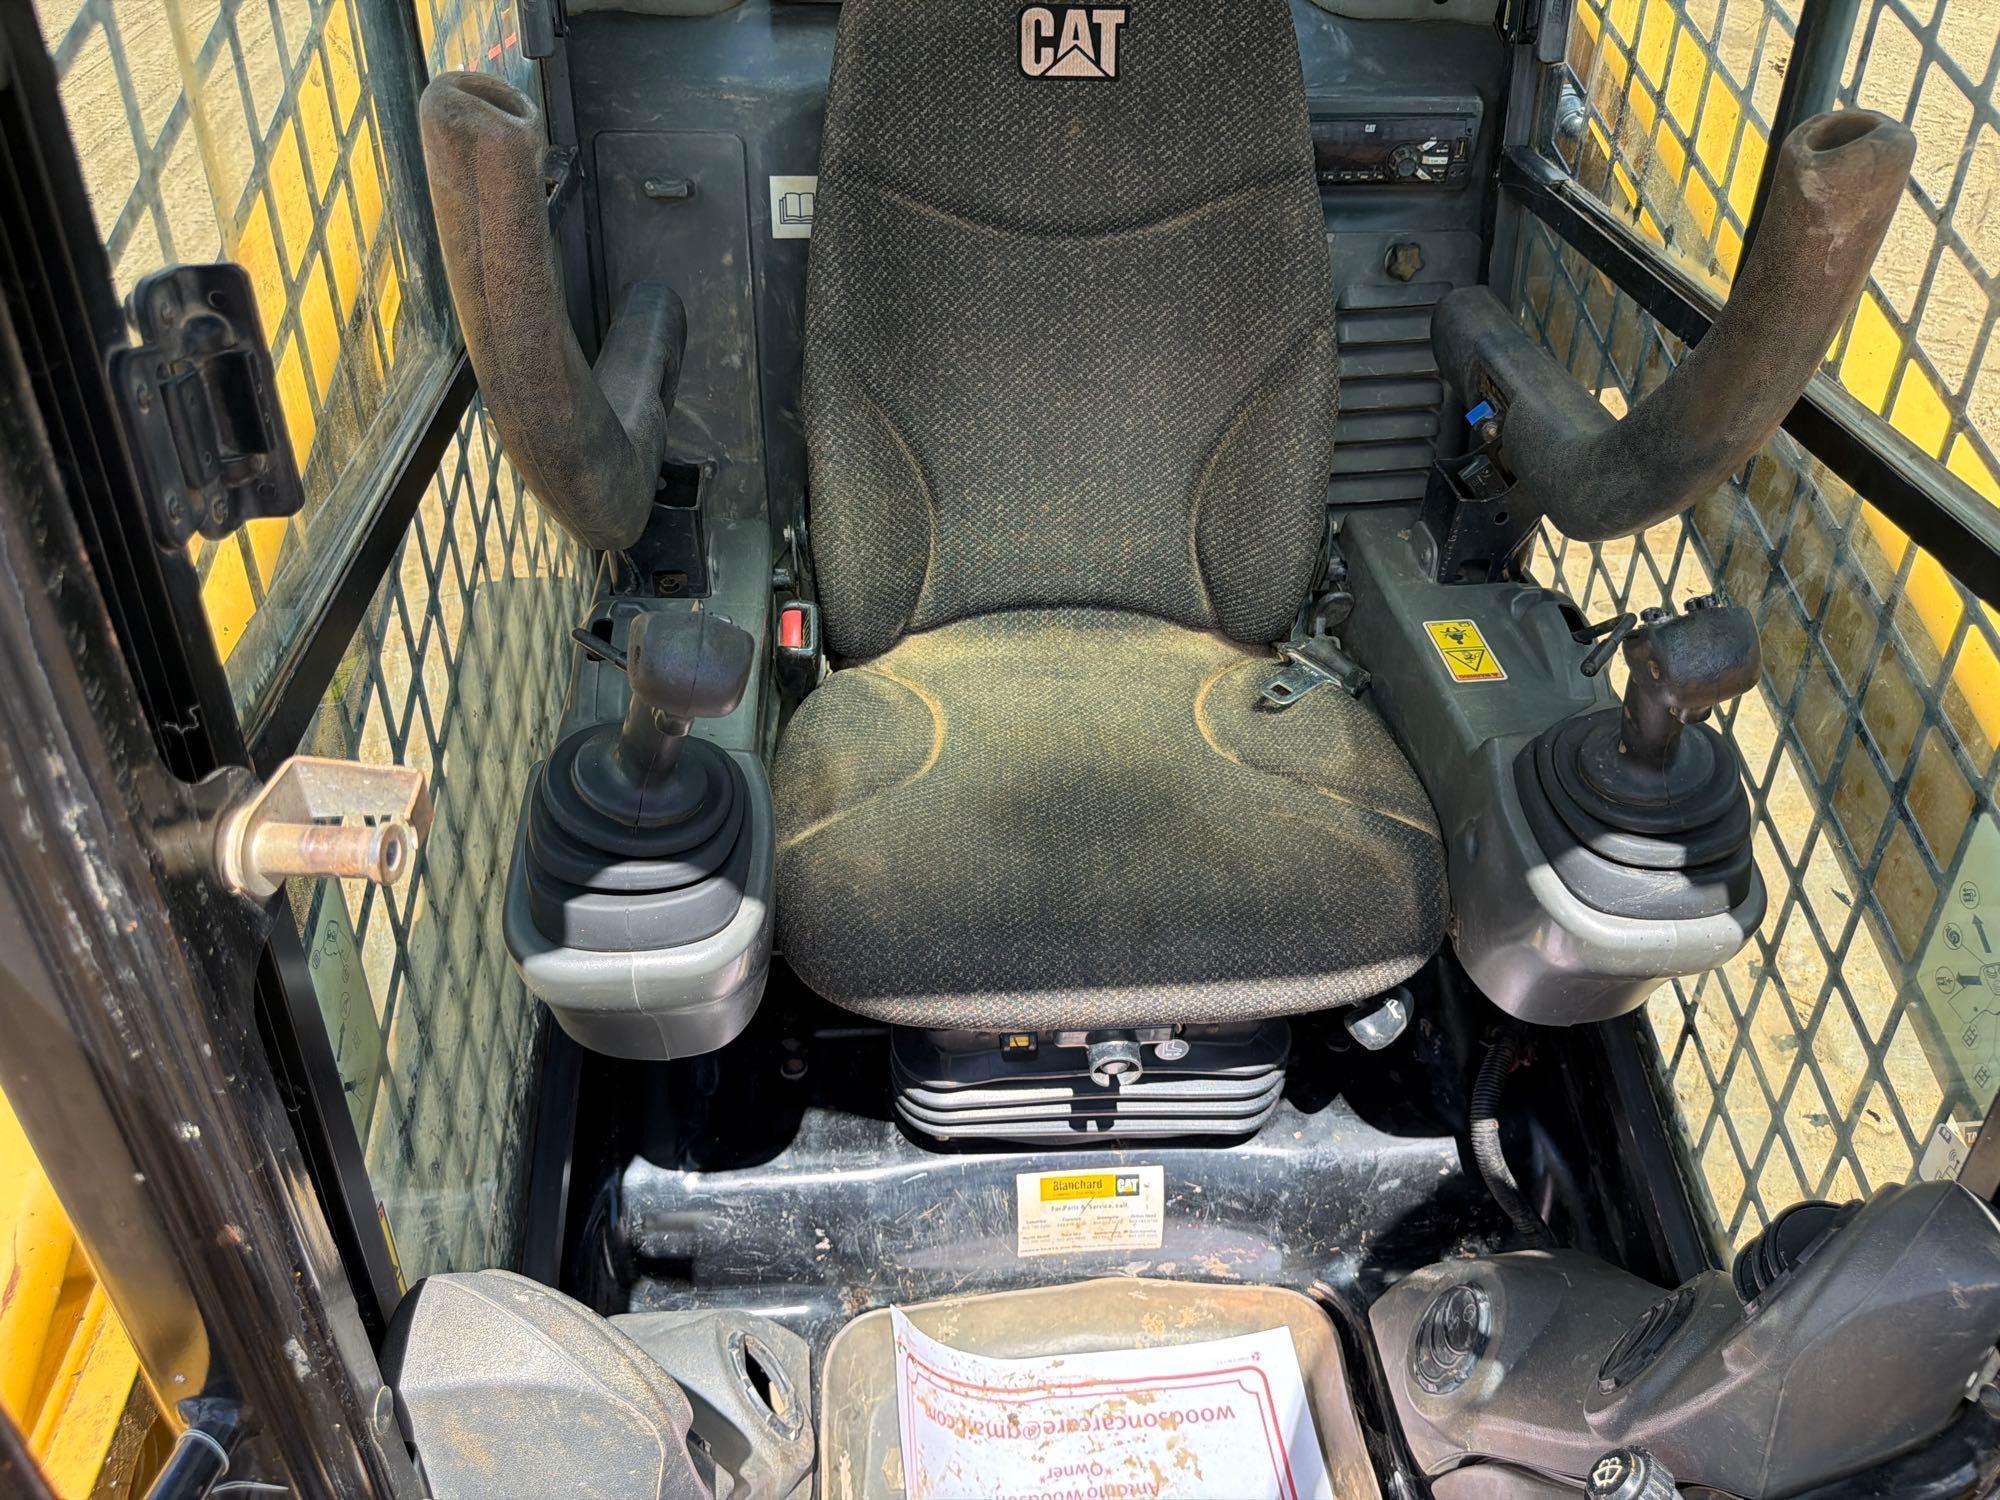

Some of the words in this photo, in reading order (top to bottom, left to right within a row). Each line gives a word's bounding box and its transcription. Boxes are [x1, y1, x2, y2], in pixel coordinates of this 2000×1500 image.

[1021, 7, 1125, 77] CAT
[1364, 124, 1376, 133] CAT
[1053, 1179, 1103, 1192] Blanchard
[1117, 1178, 1138, 1193] CAT
